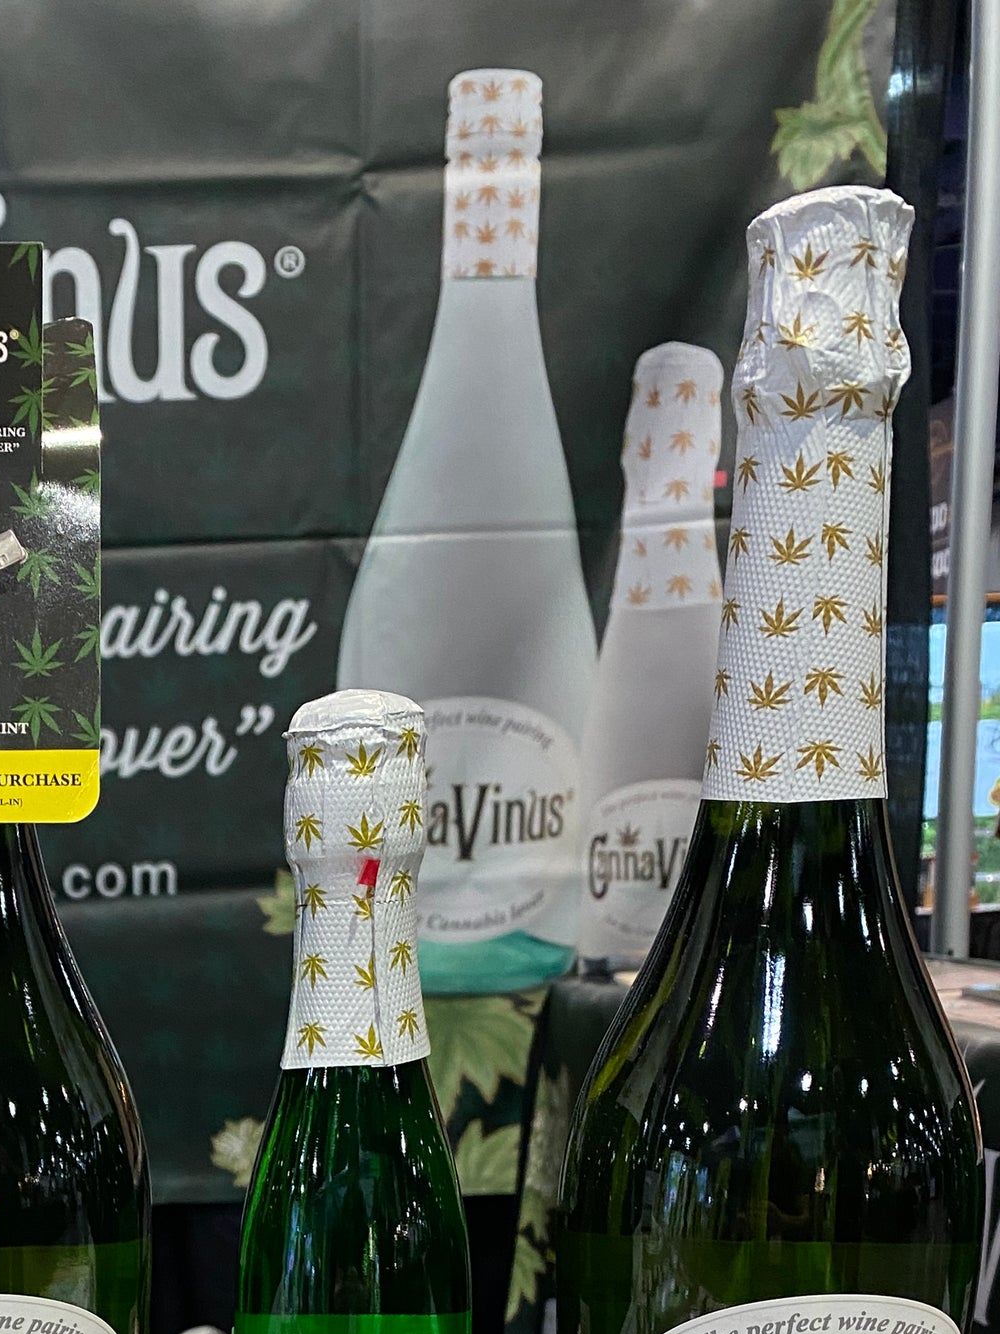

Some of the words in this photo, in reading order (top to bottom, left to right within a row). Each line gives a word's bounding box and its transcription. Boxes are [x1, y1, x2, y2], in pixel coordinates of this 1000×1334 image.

[101, 586, 318, 678] airing
[101, 704, 275, 779] over”
[427, 784, 564, 861] aVinus
[838, 1311, 888, 1332] wine
